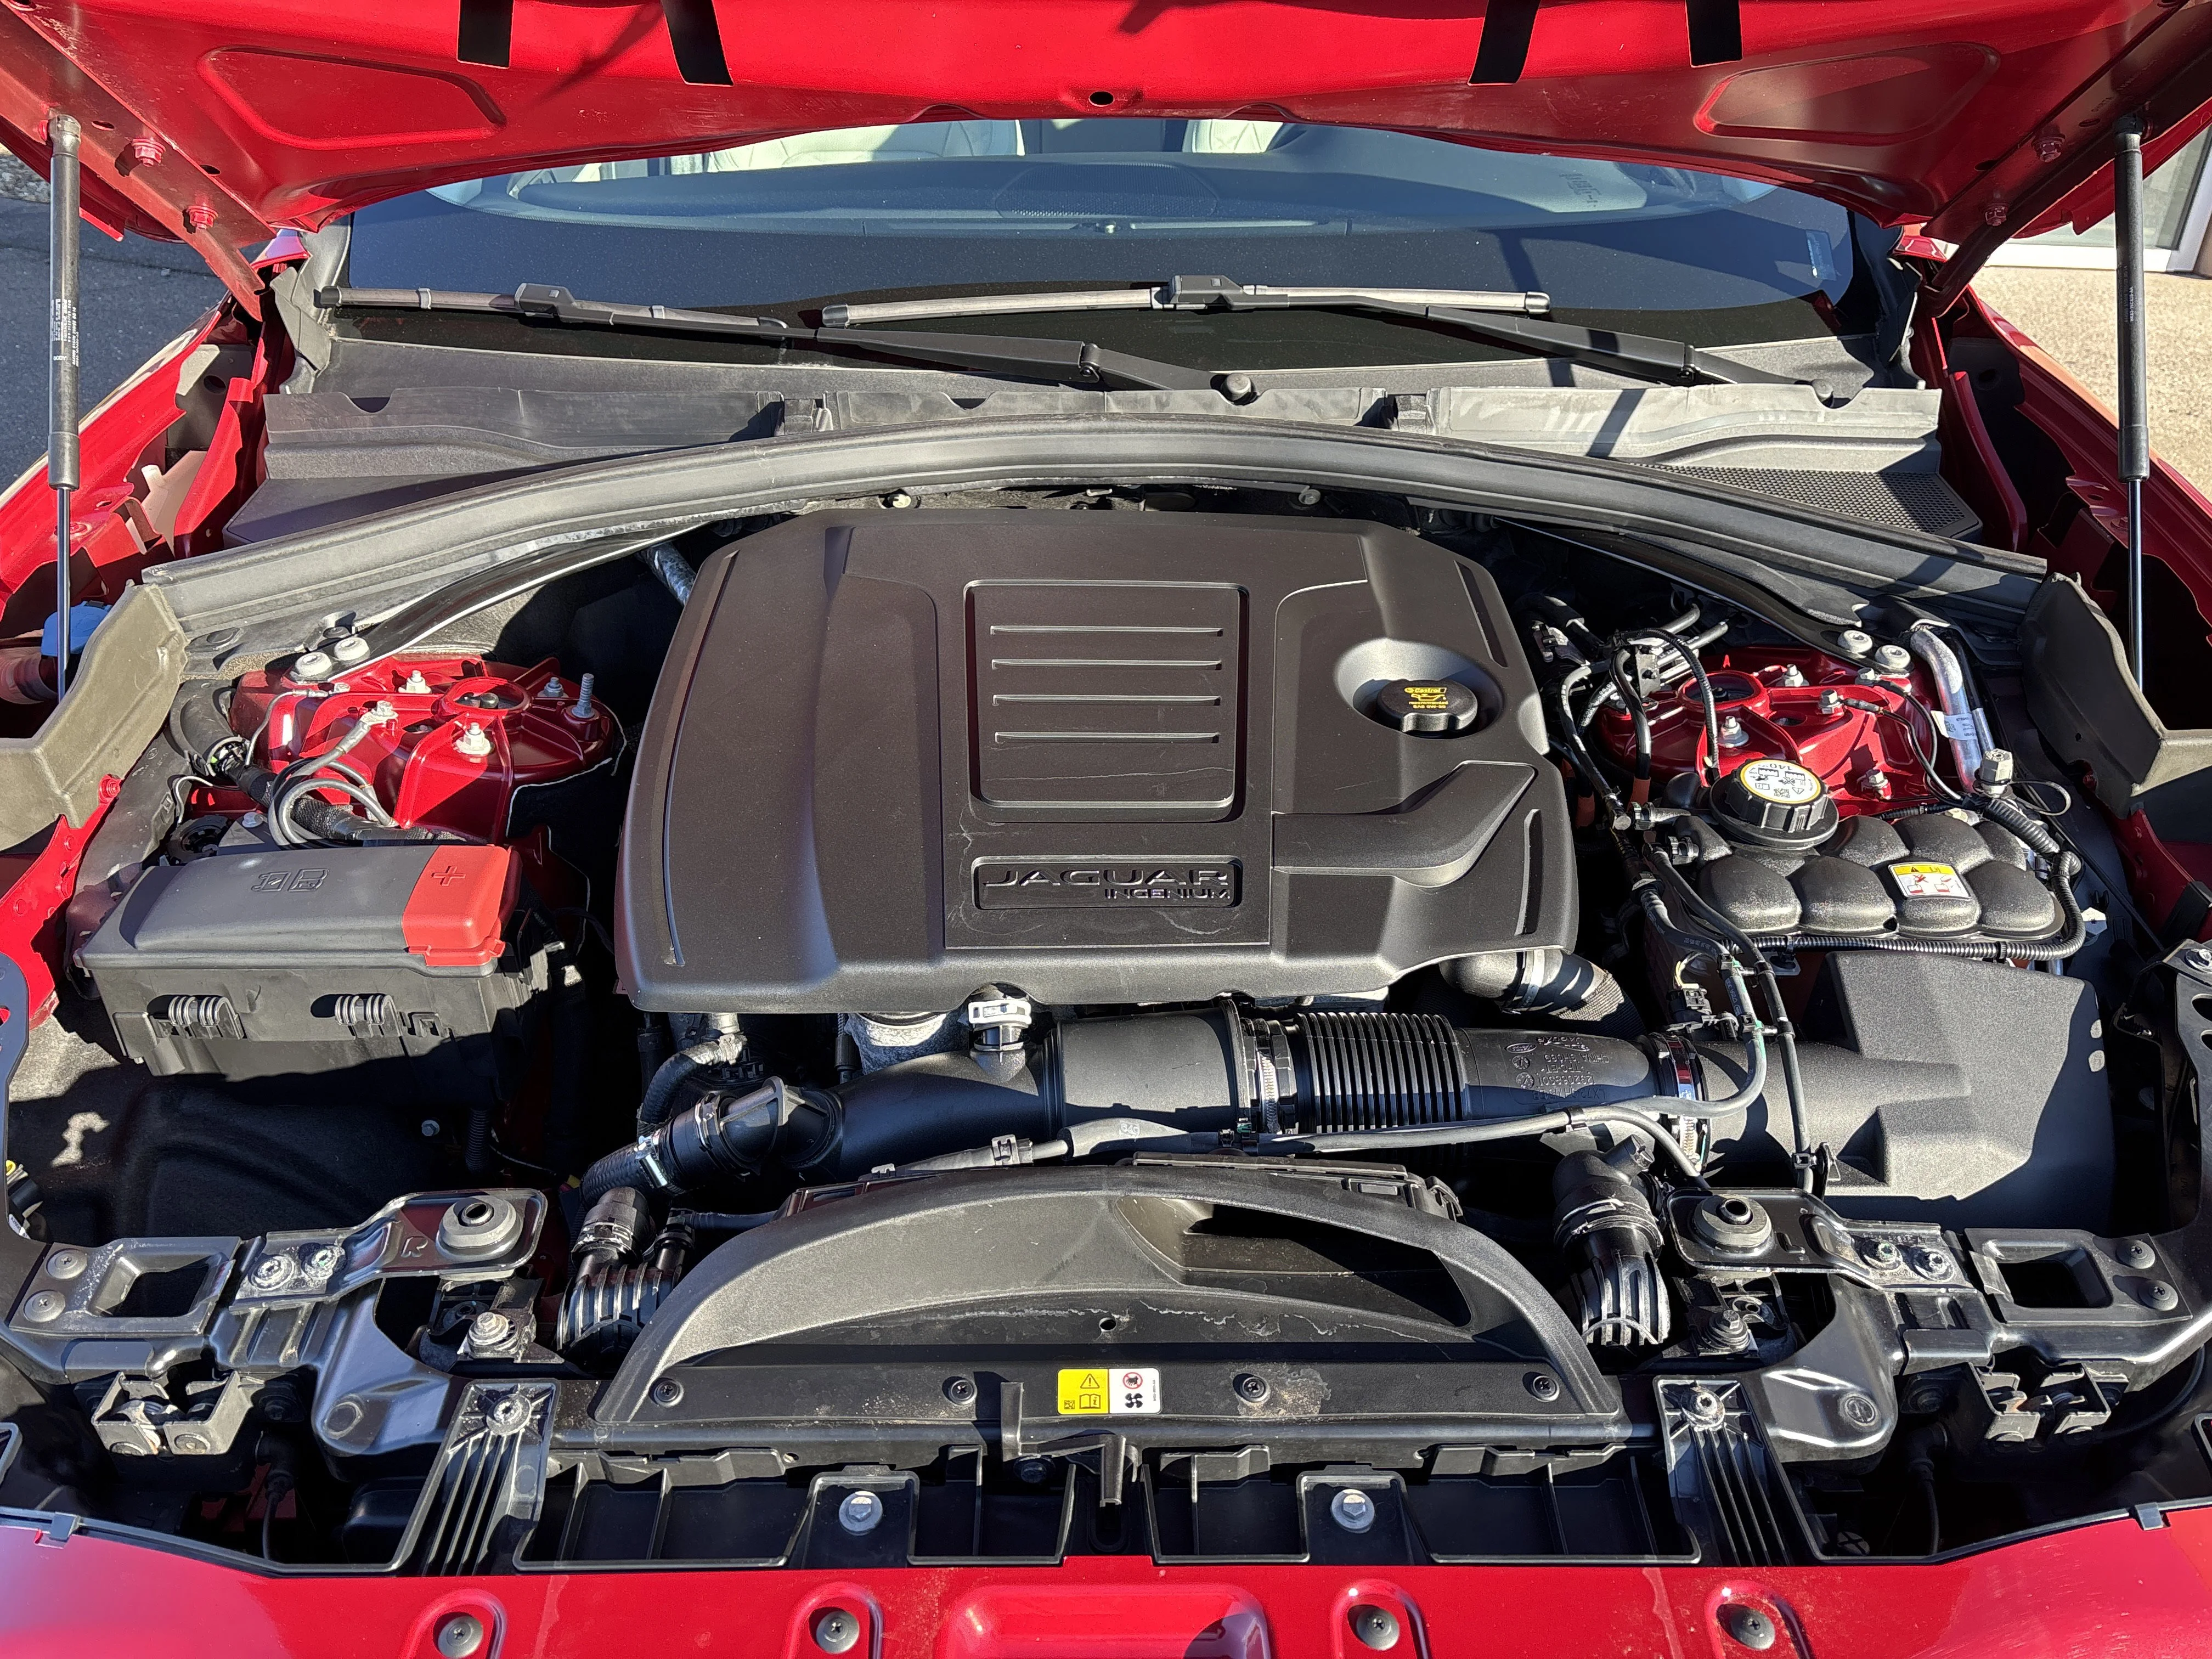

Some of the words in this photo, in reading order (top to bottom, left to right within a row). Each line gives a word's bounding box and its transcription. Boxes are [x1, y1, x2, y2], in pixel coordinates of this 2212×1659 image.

[984, 869, 1229, 887] JAGUAR
[1104, 888, 1231, 899] INGENIUM
[1579, 1053, 1610, 1063] CHINA
[401, 1236, 428, 1257] R
[1776, 1232, 1805, 1254] L
